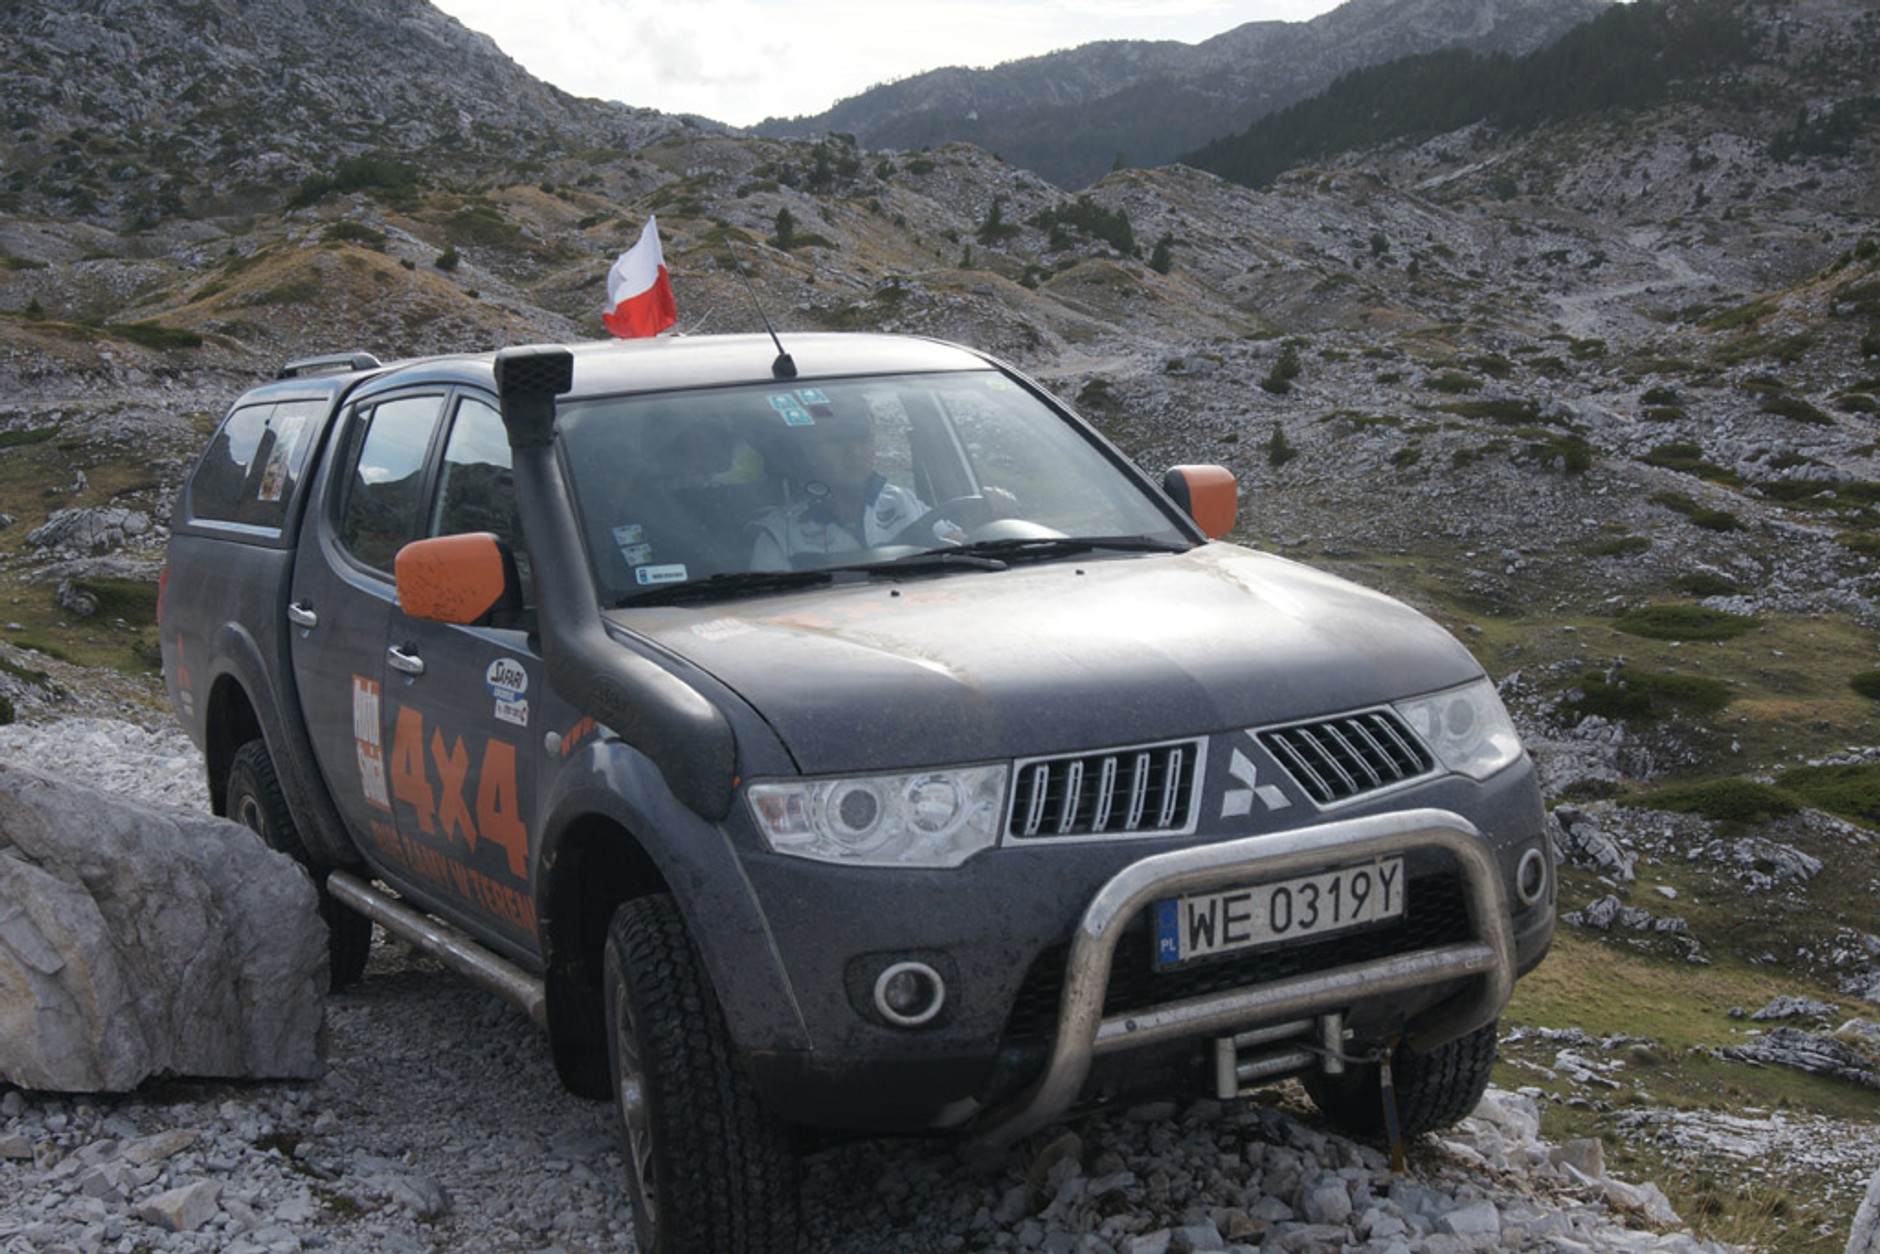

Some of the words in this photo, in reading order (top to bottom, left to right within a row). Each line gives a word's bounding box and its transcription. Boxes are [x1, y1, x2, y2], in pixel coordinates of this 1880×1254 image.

[491, 661, 525, 690] SAFARI
[1188, 893, 1252, 951] WE
[1270, 864, 1398, 934] 0319Y
[1160, 939, 1176, 953] PL
